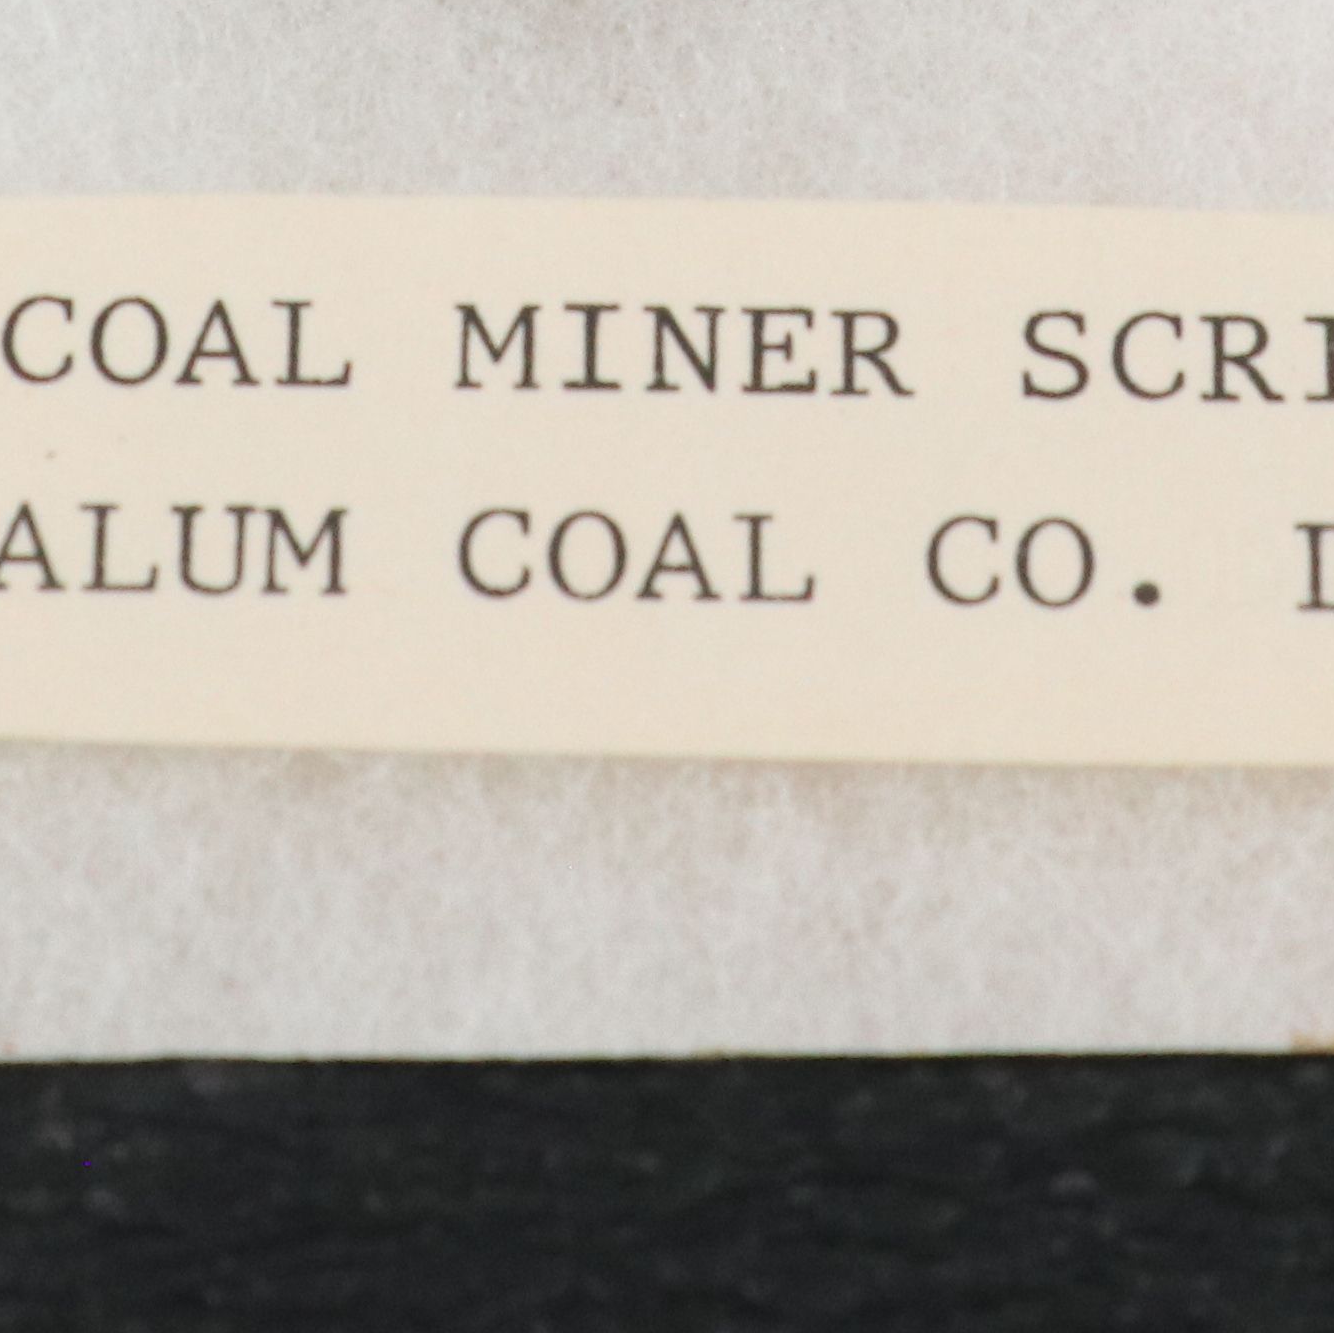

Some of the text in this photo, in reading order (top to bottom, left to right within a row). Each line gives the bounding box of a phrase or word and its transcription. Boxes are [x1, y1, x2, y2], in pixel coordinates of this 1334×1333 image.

[1, 295, 350, 386] COAL
[457, 303, 911, 396] MINER
[458, 509, 813, 601] COAL
[927, 515, 1159, 606] CO.
